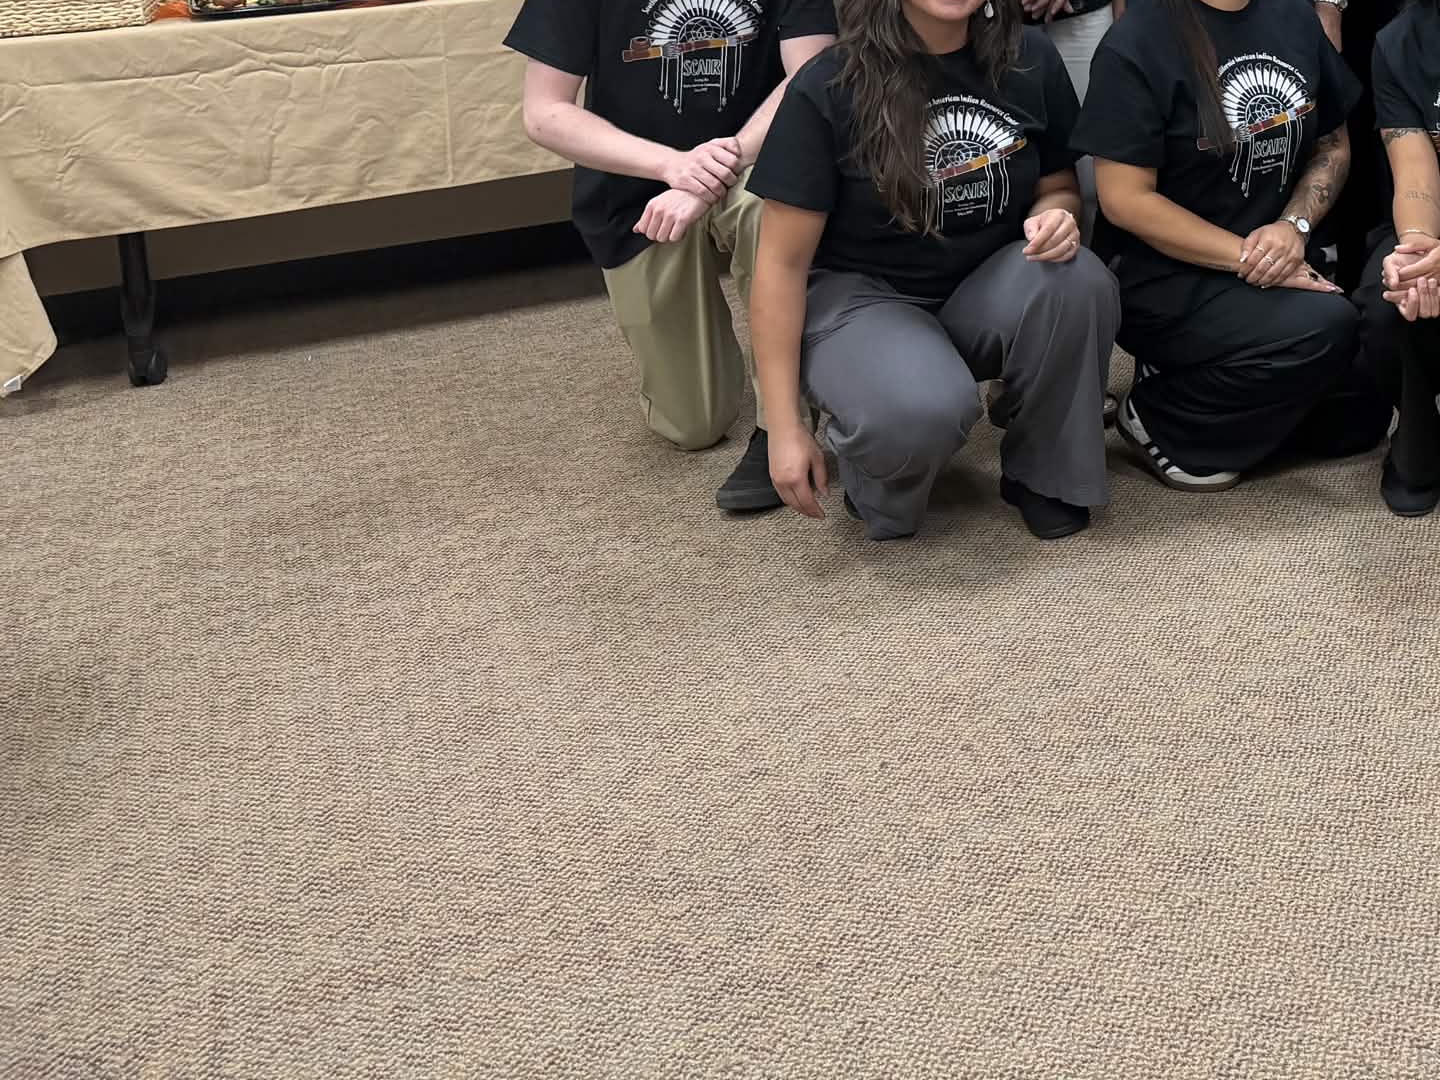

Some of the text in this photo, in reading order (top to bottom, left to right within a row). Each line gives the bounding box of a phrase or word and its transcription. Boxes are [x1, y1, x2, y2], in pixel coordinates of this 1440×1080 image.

[682, 58, 721, 76] SCAIR
[1254, 137, 1288, 159] SCAIR
[944, 180, 988, 203] SCAIR
